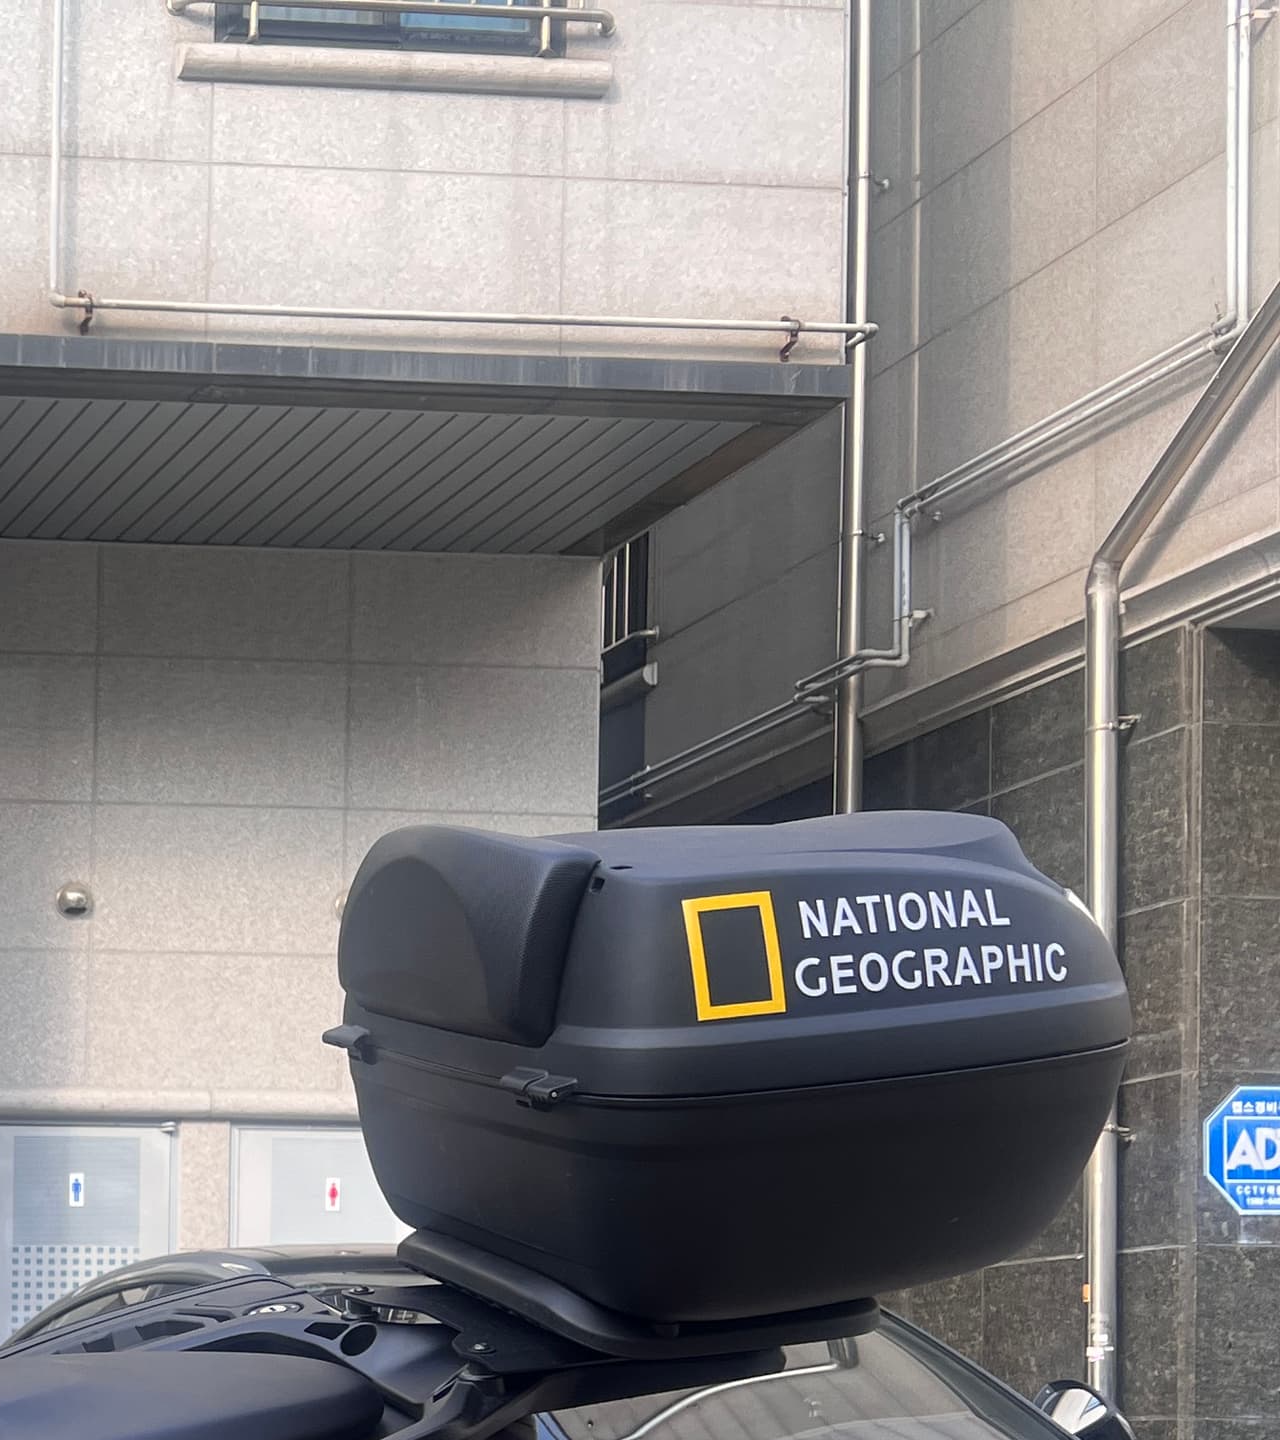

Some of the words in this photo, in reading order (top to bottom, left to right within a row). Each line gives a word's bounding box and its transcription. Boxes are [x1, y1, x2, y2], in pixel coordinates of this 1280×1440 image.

[797, 888, 1011, 939] NATIONAL
[794, 942, 1068, 997] GEOGRAPHIC
[1226, 1127, 1280, 1171] AD
